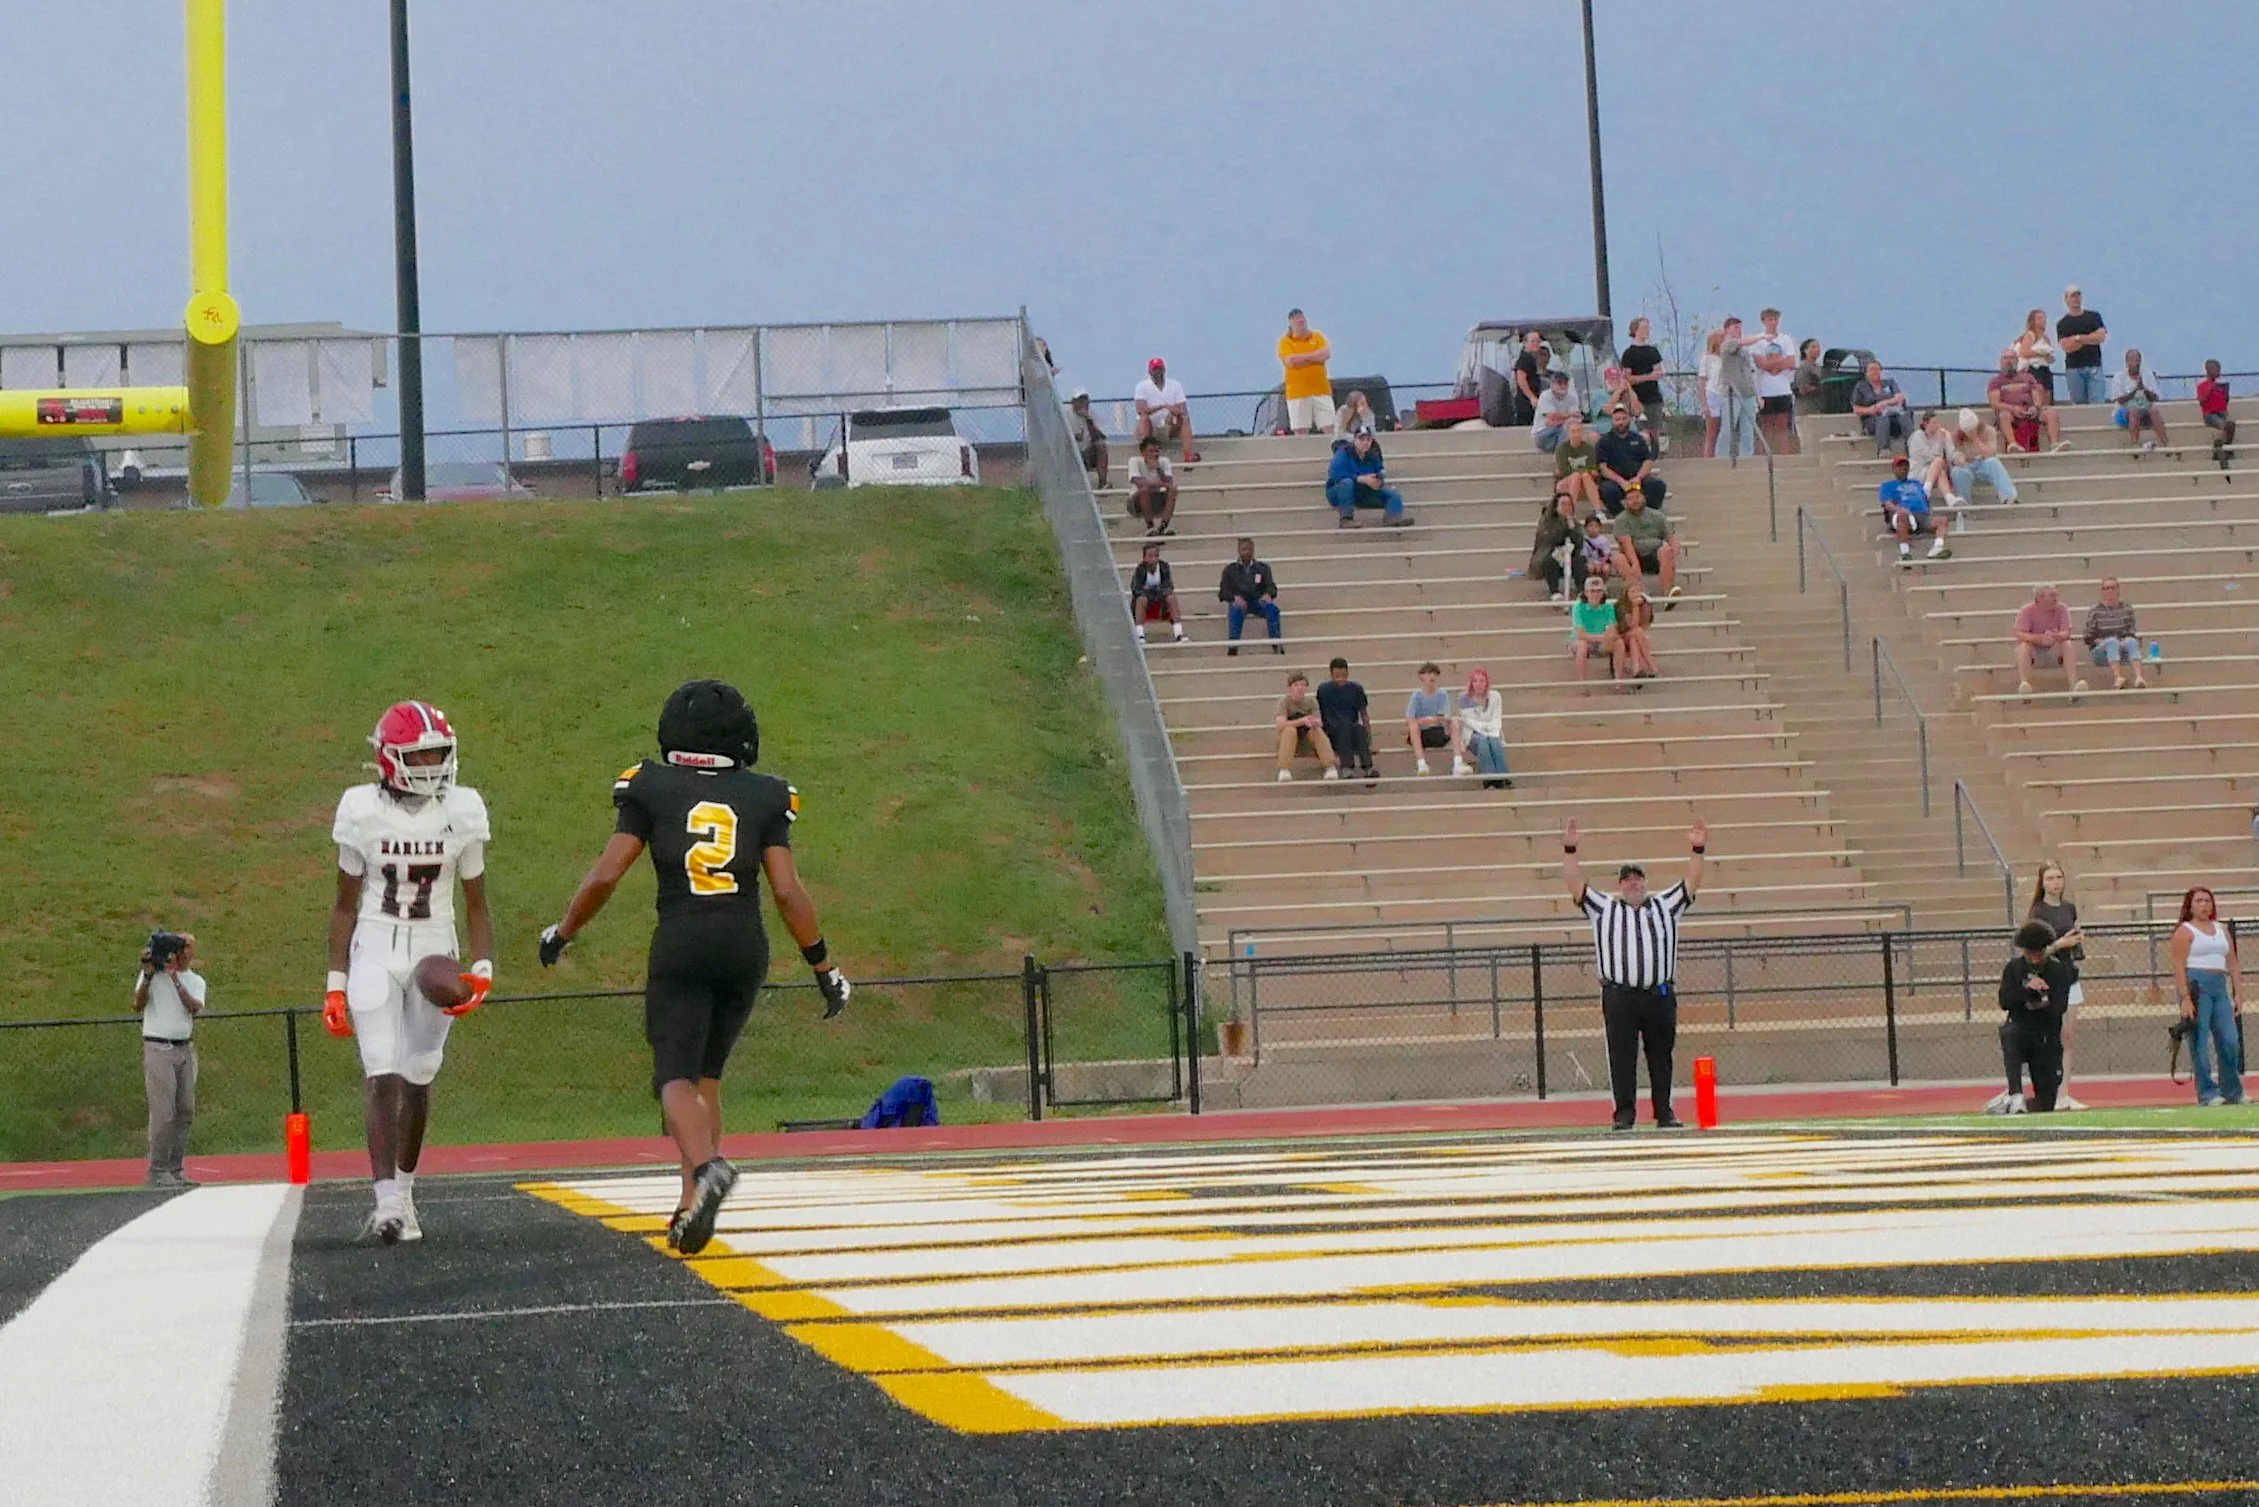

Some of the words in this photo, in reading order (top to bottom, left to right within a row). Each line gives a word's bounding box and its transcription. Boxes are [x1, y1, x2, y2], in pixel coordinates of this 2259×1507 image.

[381, 840, 444, 855] HARLEM
[685, 801, 739, 895] 2
[381, 863, 442, 919] 17
